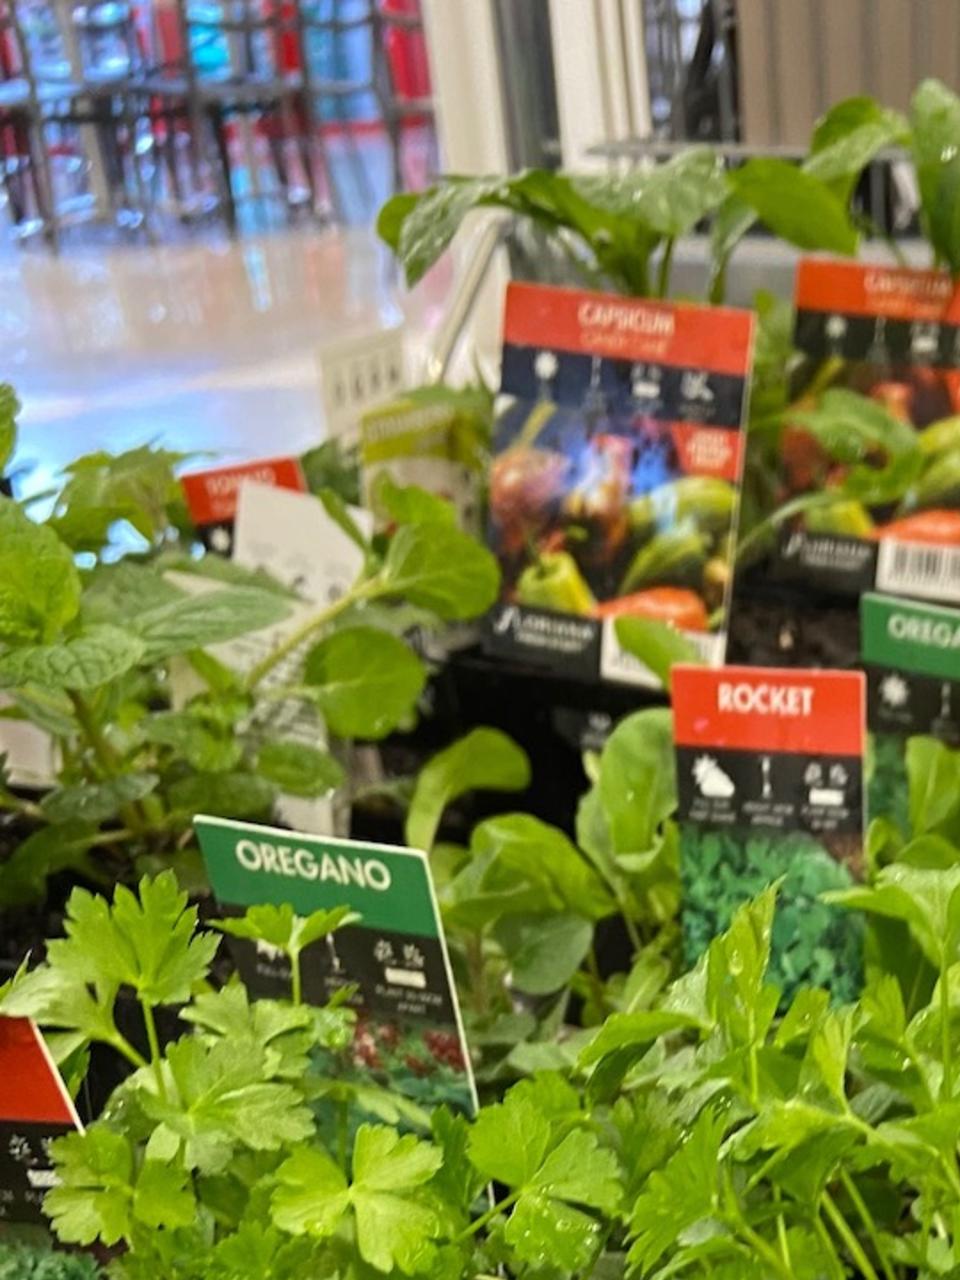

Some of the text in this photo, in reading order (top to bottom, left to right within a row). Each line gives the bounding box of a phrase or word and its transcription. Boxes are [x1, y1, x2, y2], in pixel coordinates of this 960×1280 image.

[577, 302, 675, 335] CAPSICUM
[717, 682, 813, 717] ROCKET
[236, 839, 391, 891] OREGANO
